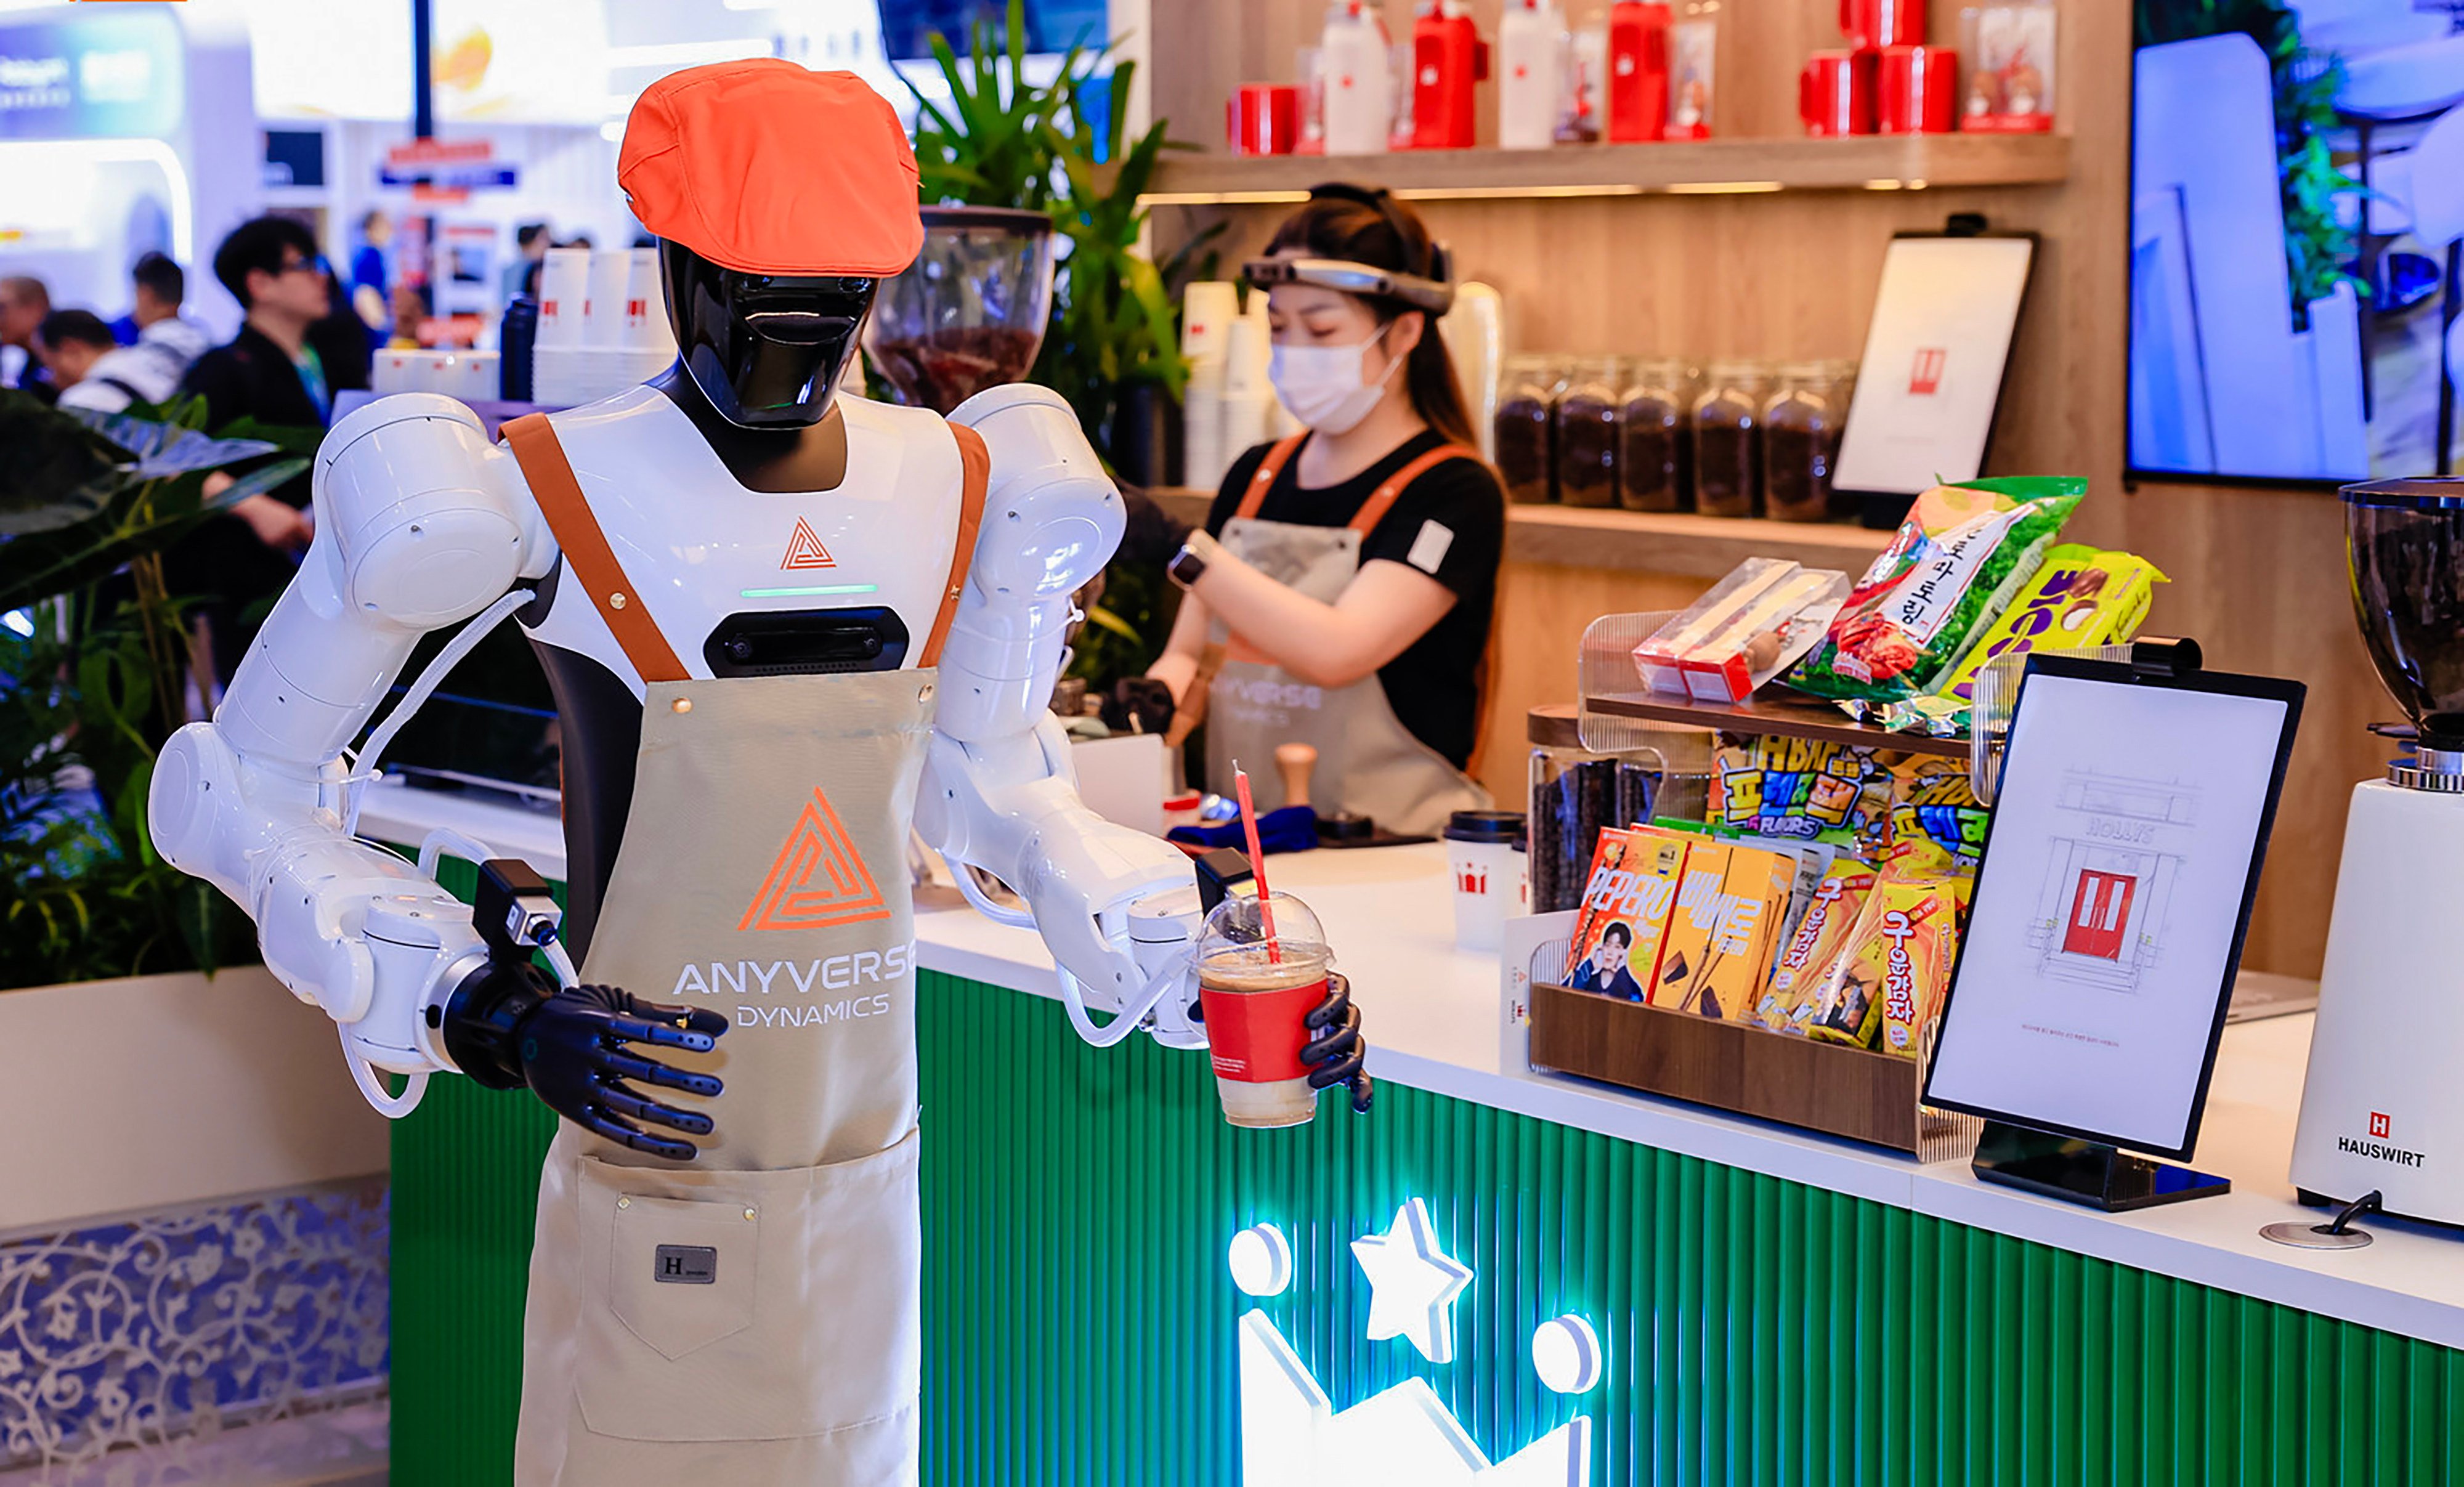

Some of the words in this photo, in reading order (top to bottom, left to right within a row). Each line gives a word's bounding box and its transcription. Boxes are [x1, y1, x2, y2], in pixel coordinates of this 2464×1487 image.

[2086, 817, 2155, 845] HOLLYS
[1580, 865, 1678, 920] PEPERO
[1676, 869, 1762, 942] 빼빼로
[1784, 878, 1844, 971] 구운감자
[1882, 910, 1914, 1024] 구운감자
[737, 993, 890, 1028] DYNAMICS
[2372, 1114, 2388, 1137] H
[2338, 1136, 2425, 1168] HAUSWIRT
[665, 1257, 682, 1275] H
